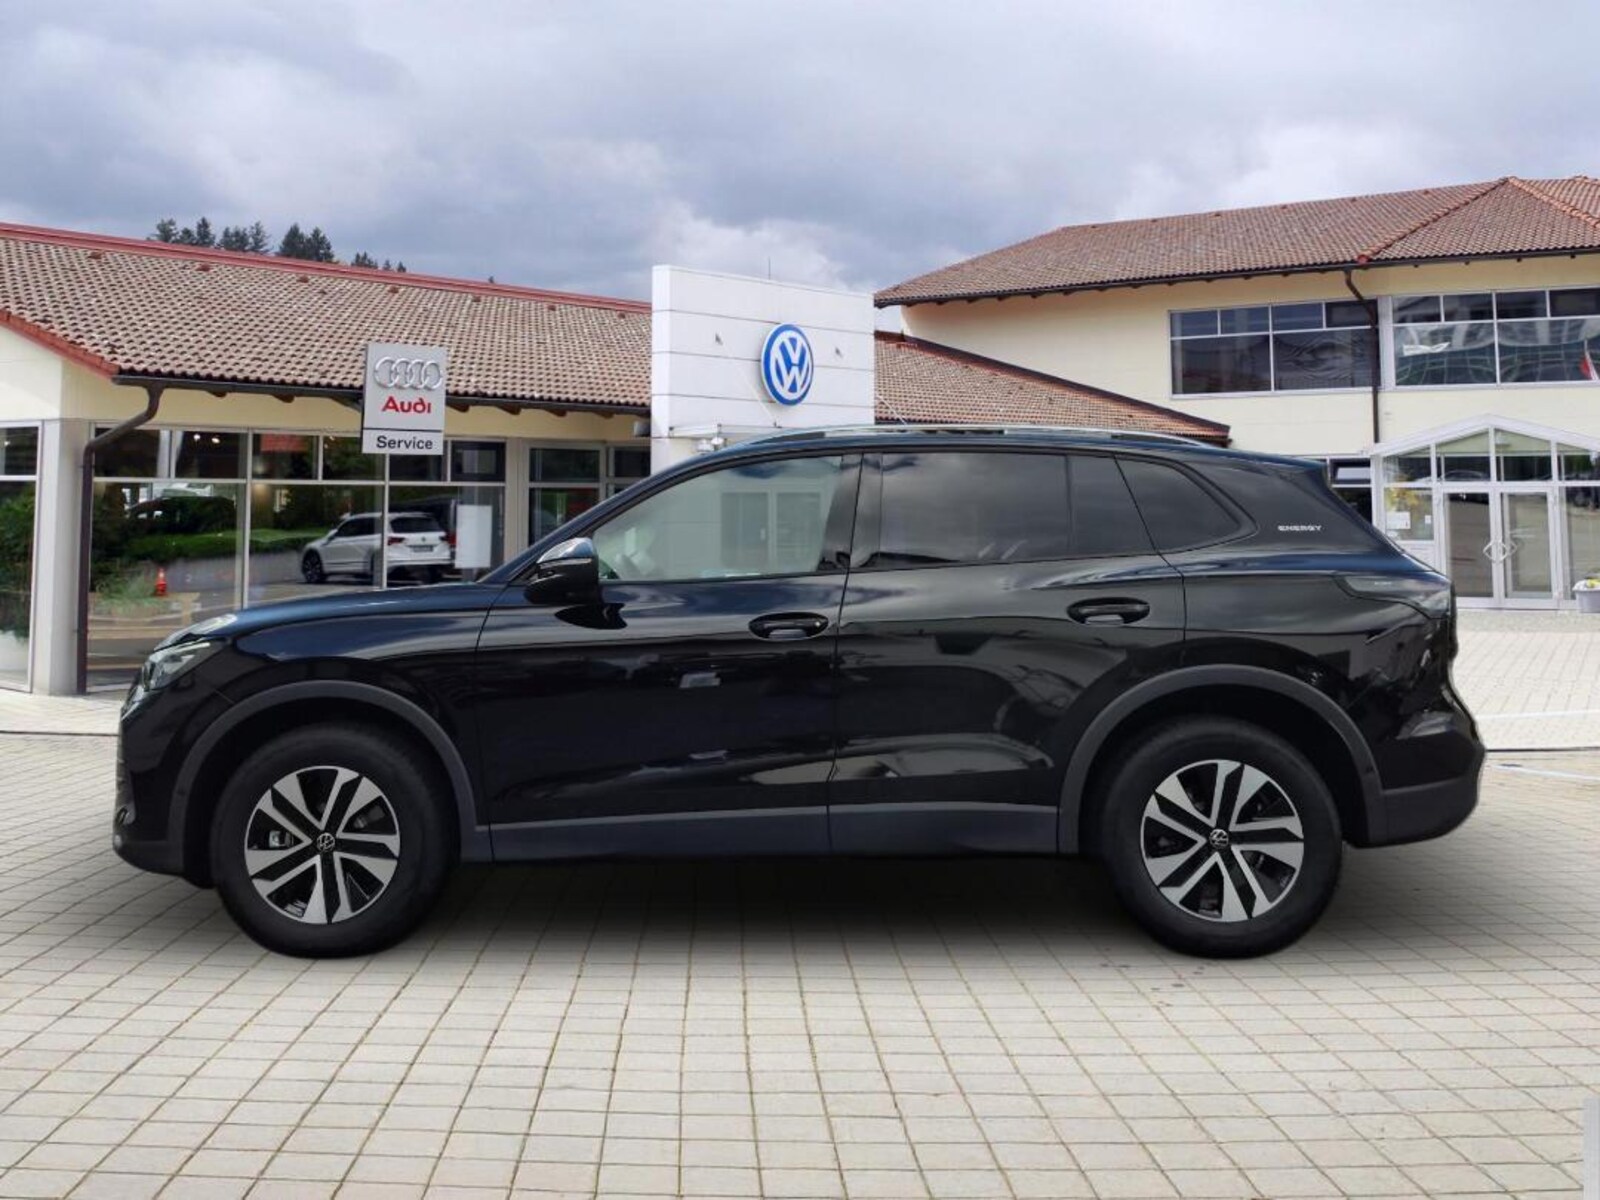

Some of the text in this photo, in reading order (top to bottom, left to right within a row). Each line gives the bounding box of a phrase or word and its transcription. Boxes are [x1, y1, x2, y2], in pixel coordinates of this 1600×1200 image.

[769, 330, 811, 399] VW
[381, 396, 432, 414] Audi
[376, 435, 433, 450] Service
